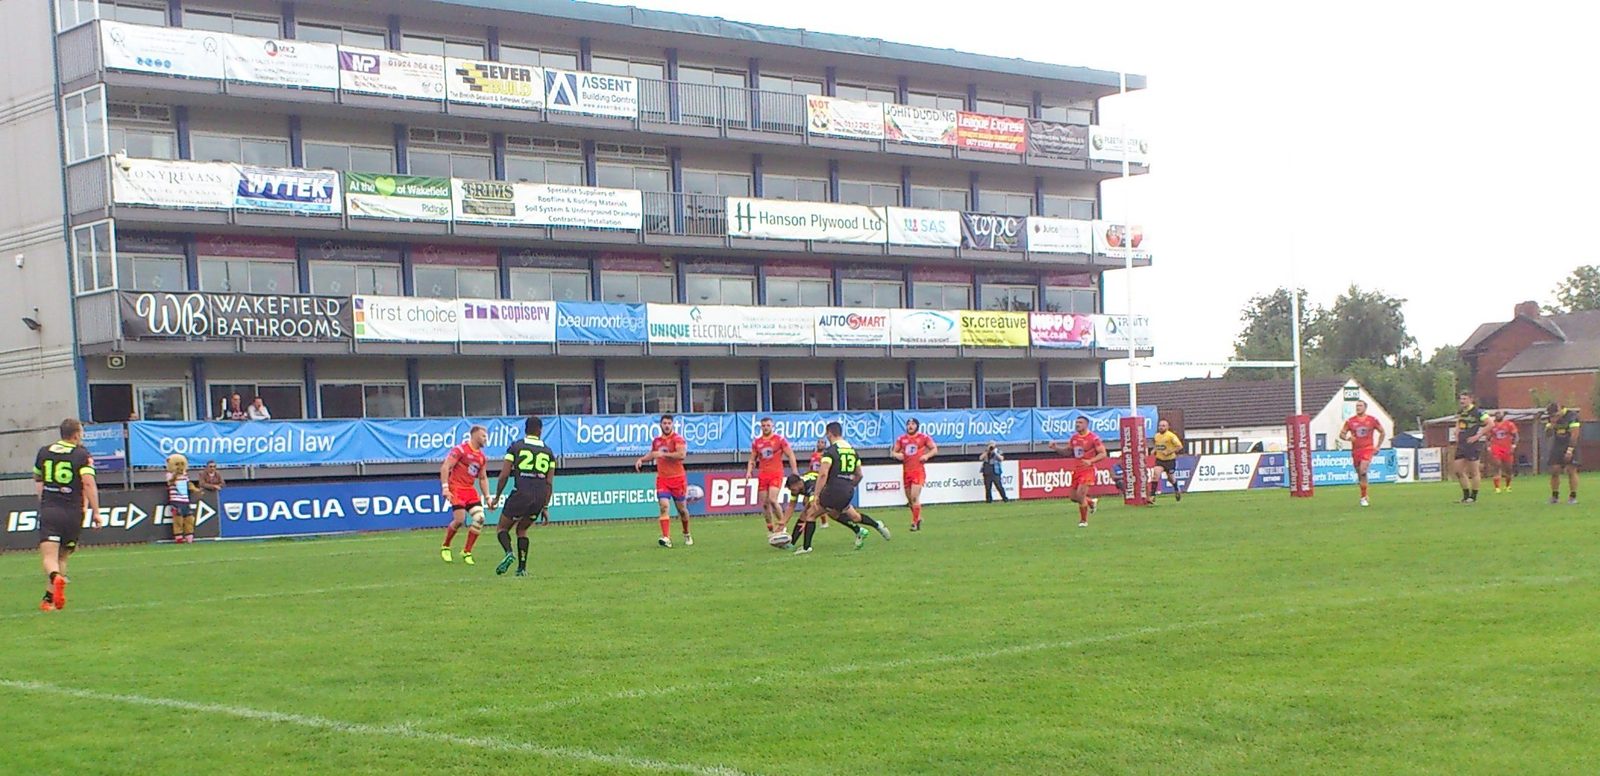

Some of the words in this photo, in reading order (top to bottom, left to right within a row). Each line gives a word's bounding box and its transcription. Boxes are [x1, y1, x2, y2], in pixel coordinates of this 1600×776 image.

[489, 64, 531, 83] EVER
[582, 76, 632, 92] ASSENT
[582, 92, 610, 103] Building
[886, 104, 912, 119] JOHN
[247, 173, 328, 198] WYTEK
[759, 211, 806, 226] Hanson
[811, 213, 858, 232] Plywood
[863, 216, 882, 231] Ltd
[213, 295, 340, 316] WAKEFIELD
[370, 303, 402, 321] first
[406, 305, 457, 323] choice
[501, 303, 550, 323] copiserv
[217, 317, 341, 338] BATHROOMS
[558, 312, 646, 332] beaumontlegal
[649, 323, 690, 339] UNIQUE
[692, 324, 742, 339] ELECTRICAL
[962, 315, 1027, 329] sr.creative
[576, 416, 723, 446] beaumotlegal
[969, 417, 1014, 435] house?
[1042, 415, 1077, 435] dispu
[160, 430, 292, 453] commercial
[299, 429, 335, 452] law
[407, 426, 457, 449] need
[518, 450, 550, 472] 26
[840, 454, 857, 473] 13
[1198, 465, 1216, 477] £30
[1234, 463, 1250, 475] £30
[43, 460, 74, 484] 16
[1022, 468, 1073, 492] Kingsto
[943, 478, 952, 488] of
[952, 478, 972, 490] Super
[246, 498, 345, 522] DACIA
[8, 511, 41, 532] IS
